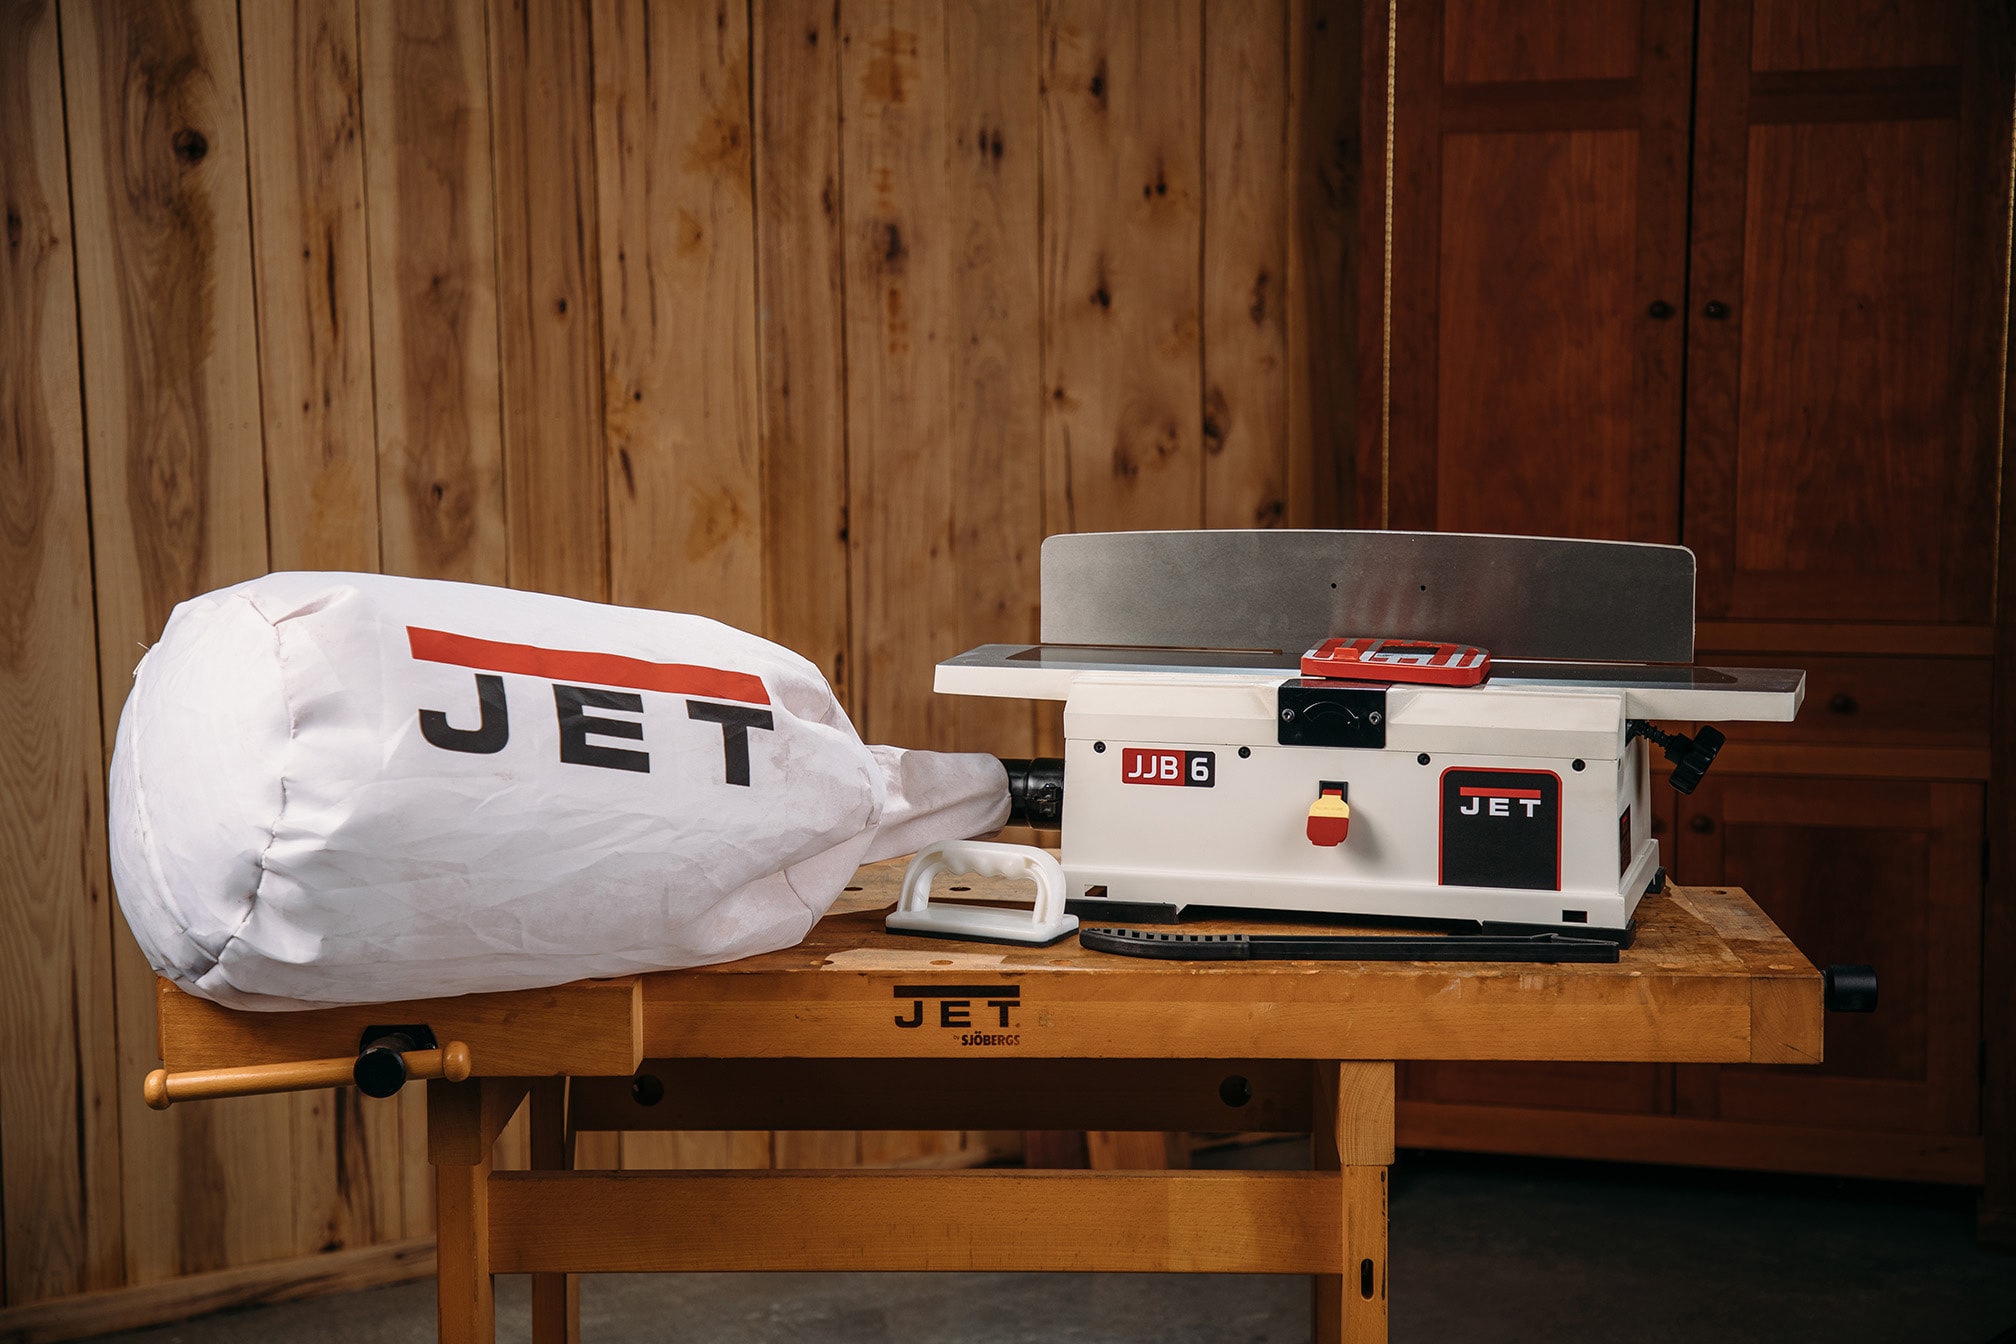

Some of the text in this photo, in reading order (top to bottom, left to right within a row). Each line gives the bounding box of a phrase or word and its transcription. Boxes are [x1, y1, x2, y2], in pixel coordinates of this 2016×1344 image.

[418, 673, 774, 787] JET
[1127, 754, 1209, 782] JJB 6
[1460, 796, 1542, 818] JET
[894, 1000, 1021, 1029] JET
[961, 1030, 1021, 1047] SJÖBERGS
